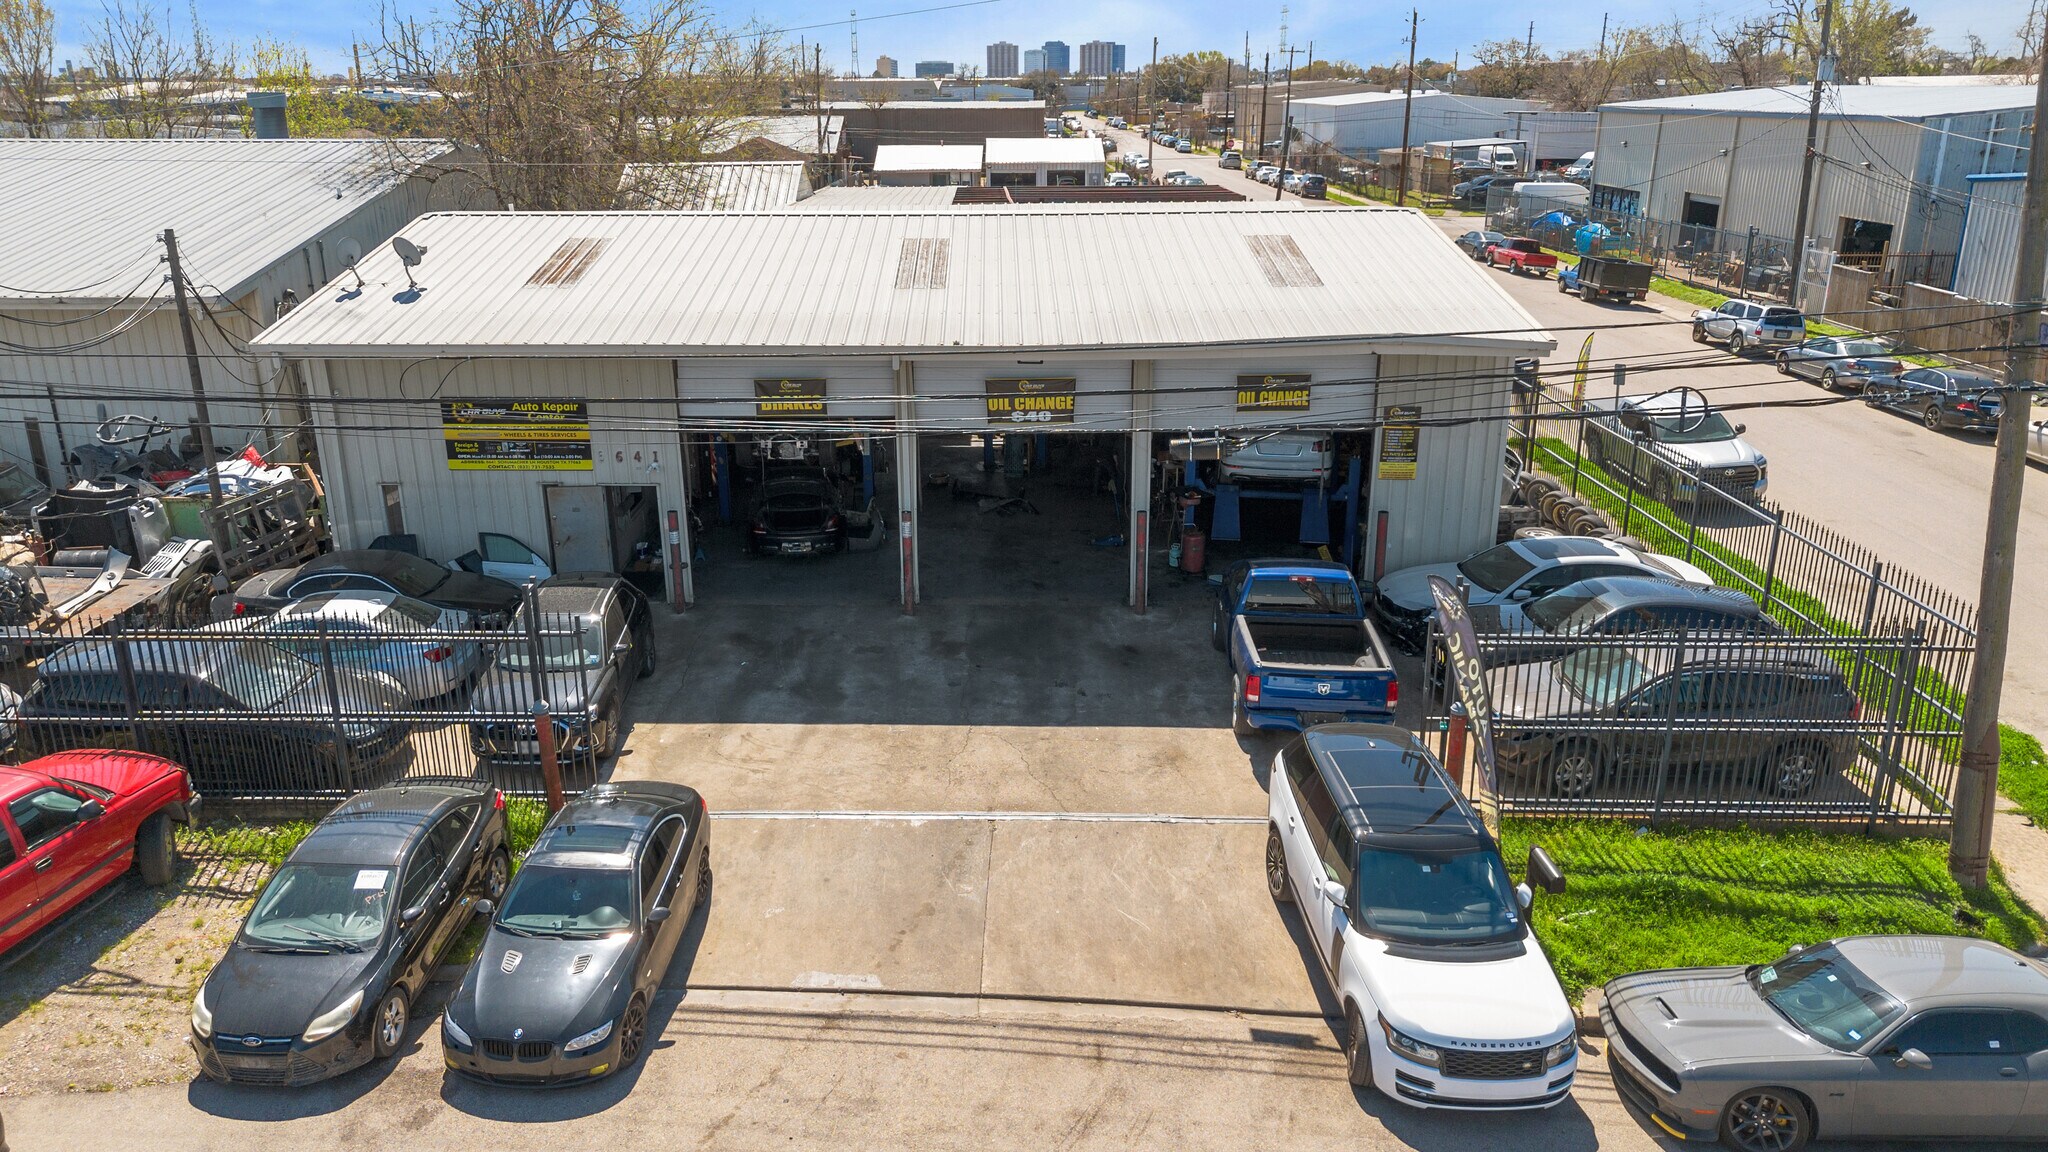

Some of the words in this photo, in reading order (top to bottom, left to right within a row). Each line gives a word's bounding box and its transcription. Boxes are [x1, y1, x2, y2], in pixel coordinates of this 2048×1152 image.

[760, 395, 823, 411] BRAKES
[987, 397, 1012, 411] OIL
[1014, 395, 1074, 411] CHANGE
[1238, 391, 1257, 407] OIL
[1259, 390, 1309, 407] CHANGE
[512, 402, 539, 411] Auto
[542, 402, 579, 413] Repair
